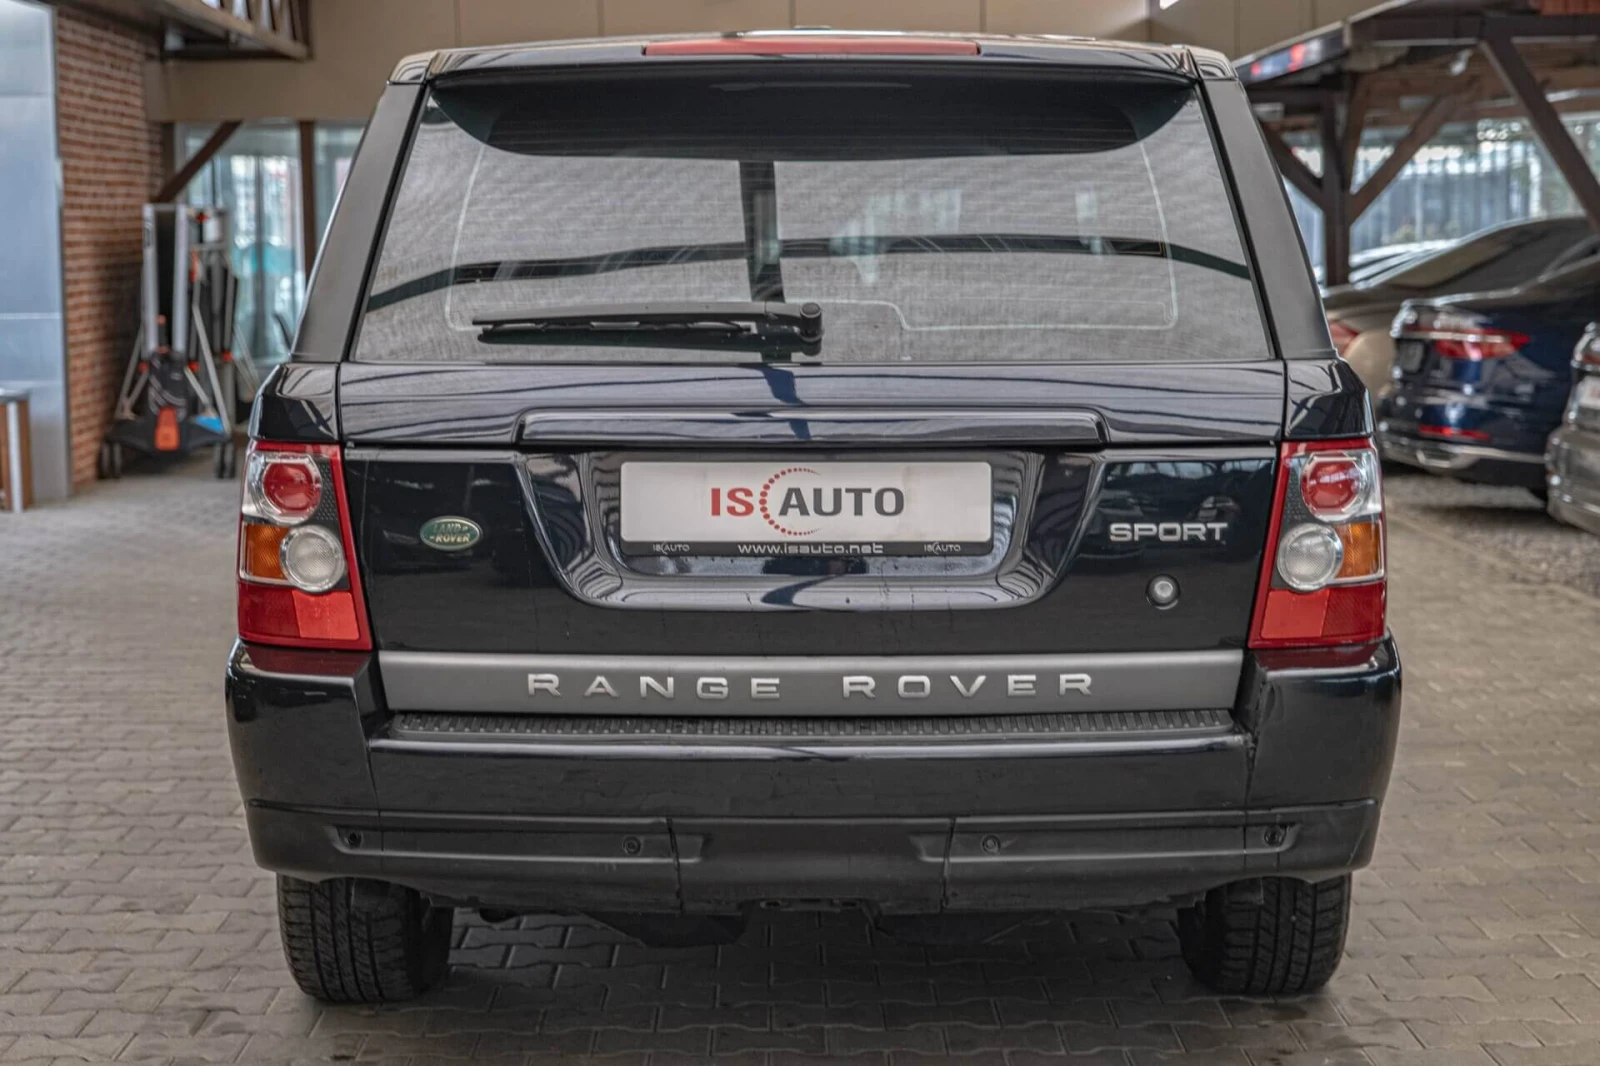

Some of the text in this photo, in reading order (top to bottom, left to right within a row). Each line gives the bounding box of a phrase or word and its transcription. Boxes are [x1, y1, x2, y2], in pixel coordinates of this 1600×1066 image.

[778, 487, 905, 517] AUTO
[1110, 522, 1228, 541] SPORT
[737, 542, 884, 554] www.isauto.net
[527, 673, 1092, 699] RANGE ROVER
